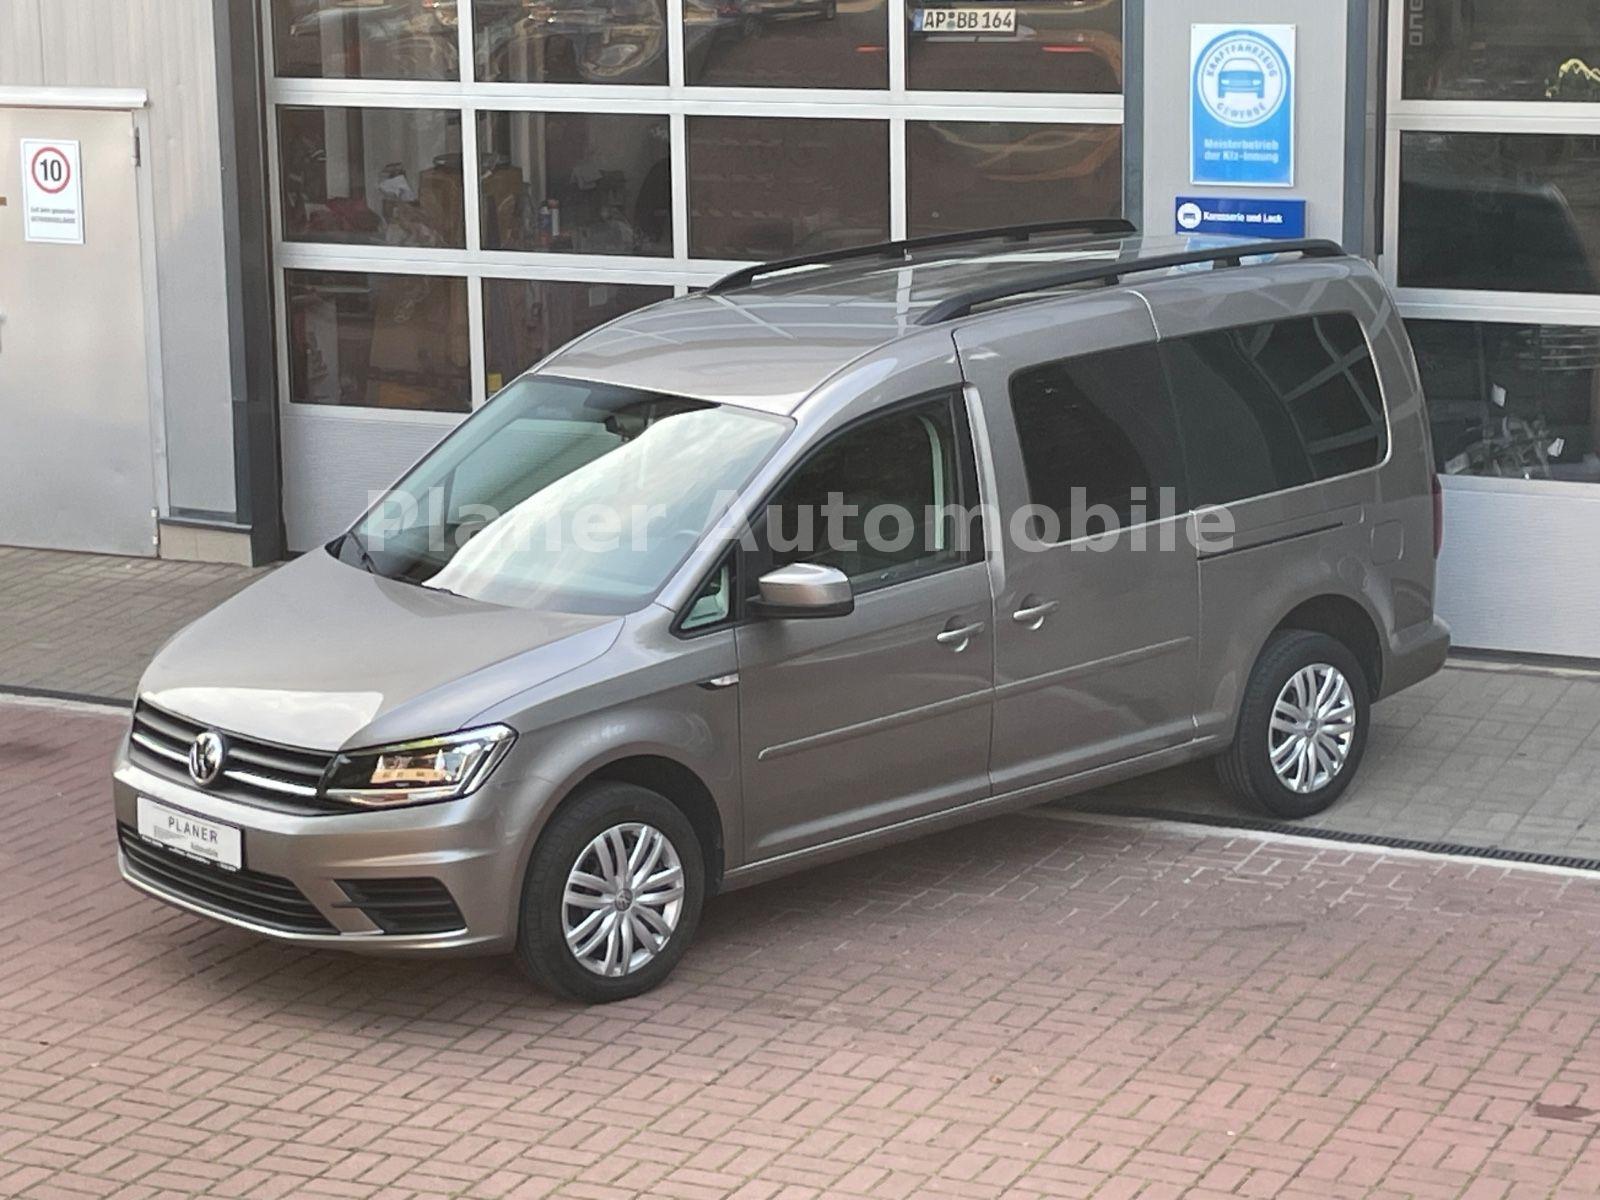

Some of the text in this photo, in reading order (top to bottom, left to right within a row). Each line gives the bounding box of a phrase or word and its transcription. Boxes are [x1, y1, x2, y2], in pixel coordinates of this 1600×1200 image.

[924, 11, 1012, 29] AP BB 164
[1206, 44, 1278, 77] KRAFTFAHRZEUG
[1204, 138, 1279, 151] Meisterbetrieb
[1204, 151, 1279, 165] der Kfz-Innung
[40, 158, 62, 182] 10
[1246, 213, 1262, 223] und
[1263, 213, 1283, 224] Lack
[168, 815, 218, 845] PLANER
